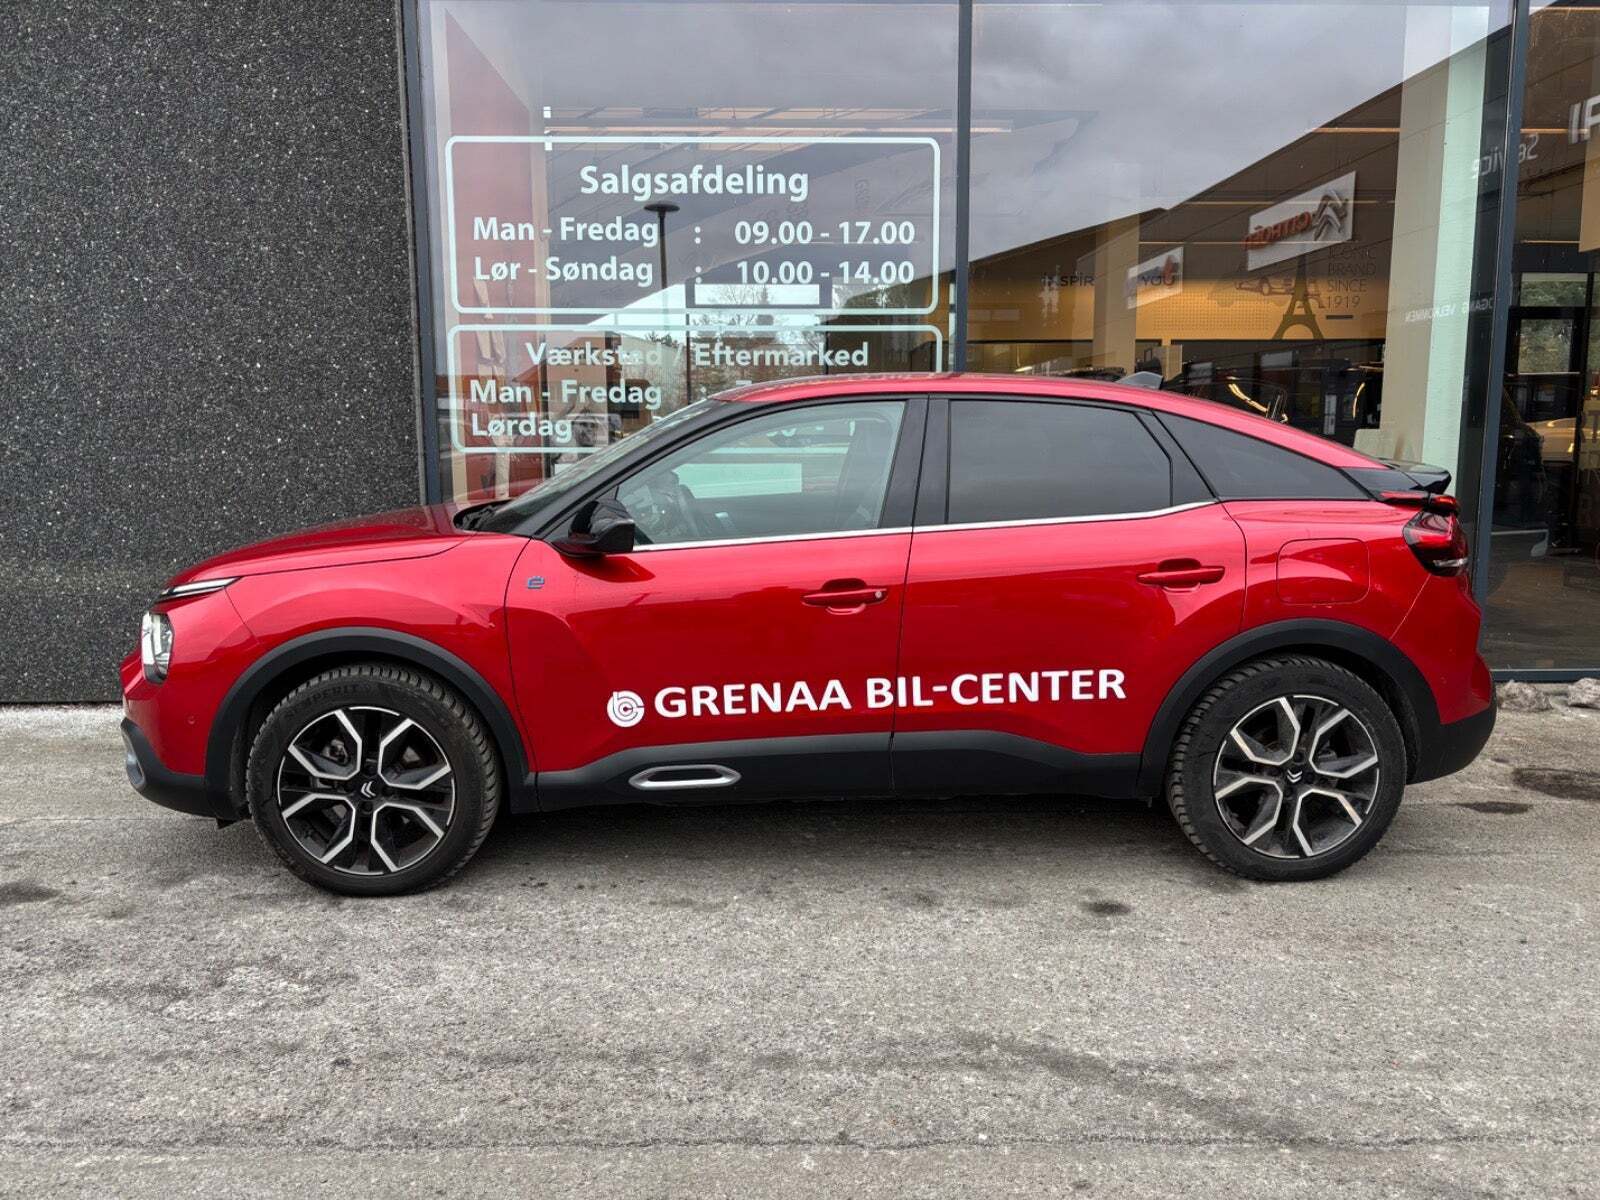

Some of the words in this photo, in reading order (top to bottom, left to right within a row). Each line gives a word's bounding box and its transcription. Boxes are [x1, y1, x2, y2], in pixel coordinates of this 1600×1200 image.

[580, 164, 809, 202] Salgsafdeling
[472, 216, 535, 241] Man
[560, 216, 658, 247] Fredag
[735, 221, 813, 244] 09.00
[838, 221, 915, 244] 17.00
[474, 257, 521, 281] Lør
[545, 256, 653, 287] Søndag
[737, 261, 813, 284] 10.00
[838, 261, 915, 284] 14.00
[1327, 279, 1367, 293] SINCE
[1328, 295, 1360, 309] 1919
[525, 341, 662, 366] Værksted
[695, 341, 869, 367] Eftermarked
[470, 379, 533, 403] Man
[561, 378, 662, 409] Fredag
[472, 413, 573, 443] Lørdag
[655, 680, 852, 718] GRENAA
[866, 669, 1127, 709] BIL-CENTER
